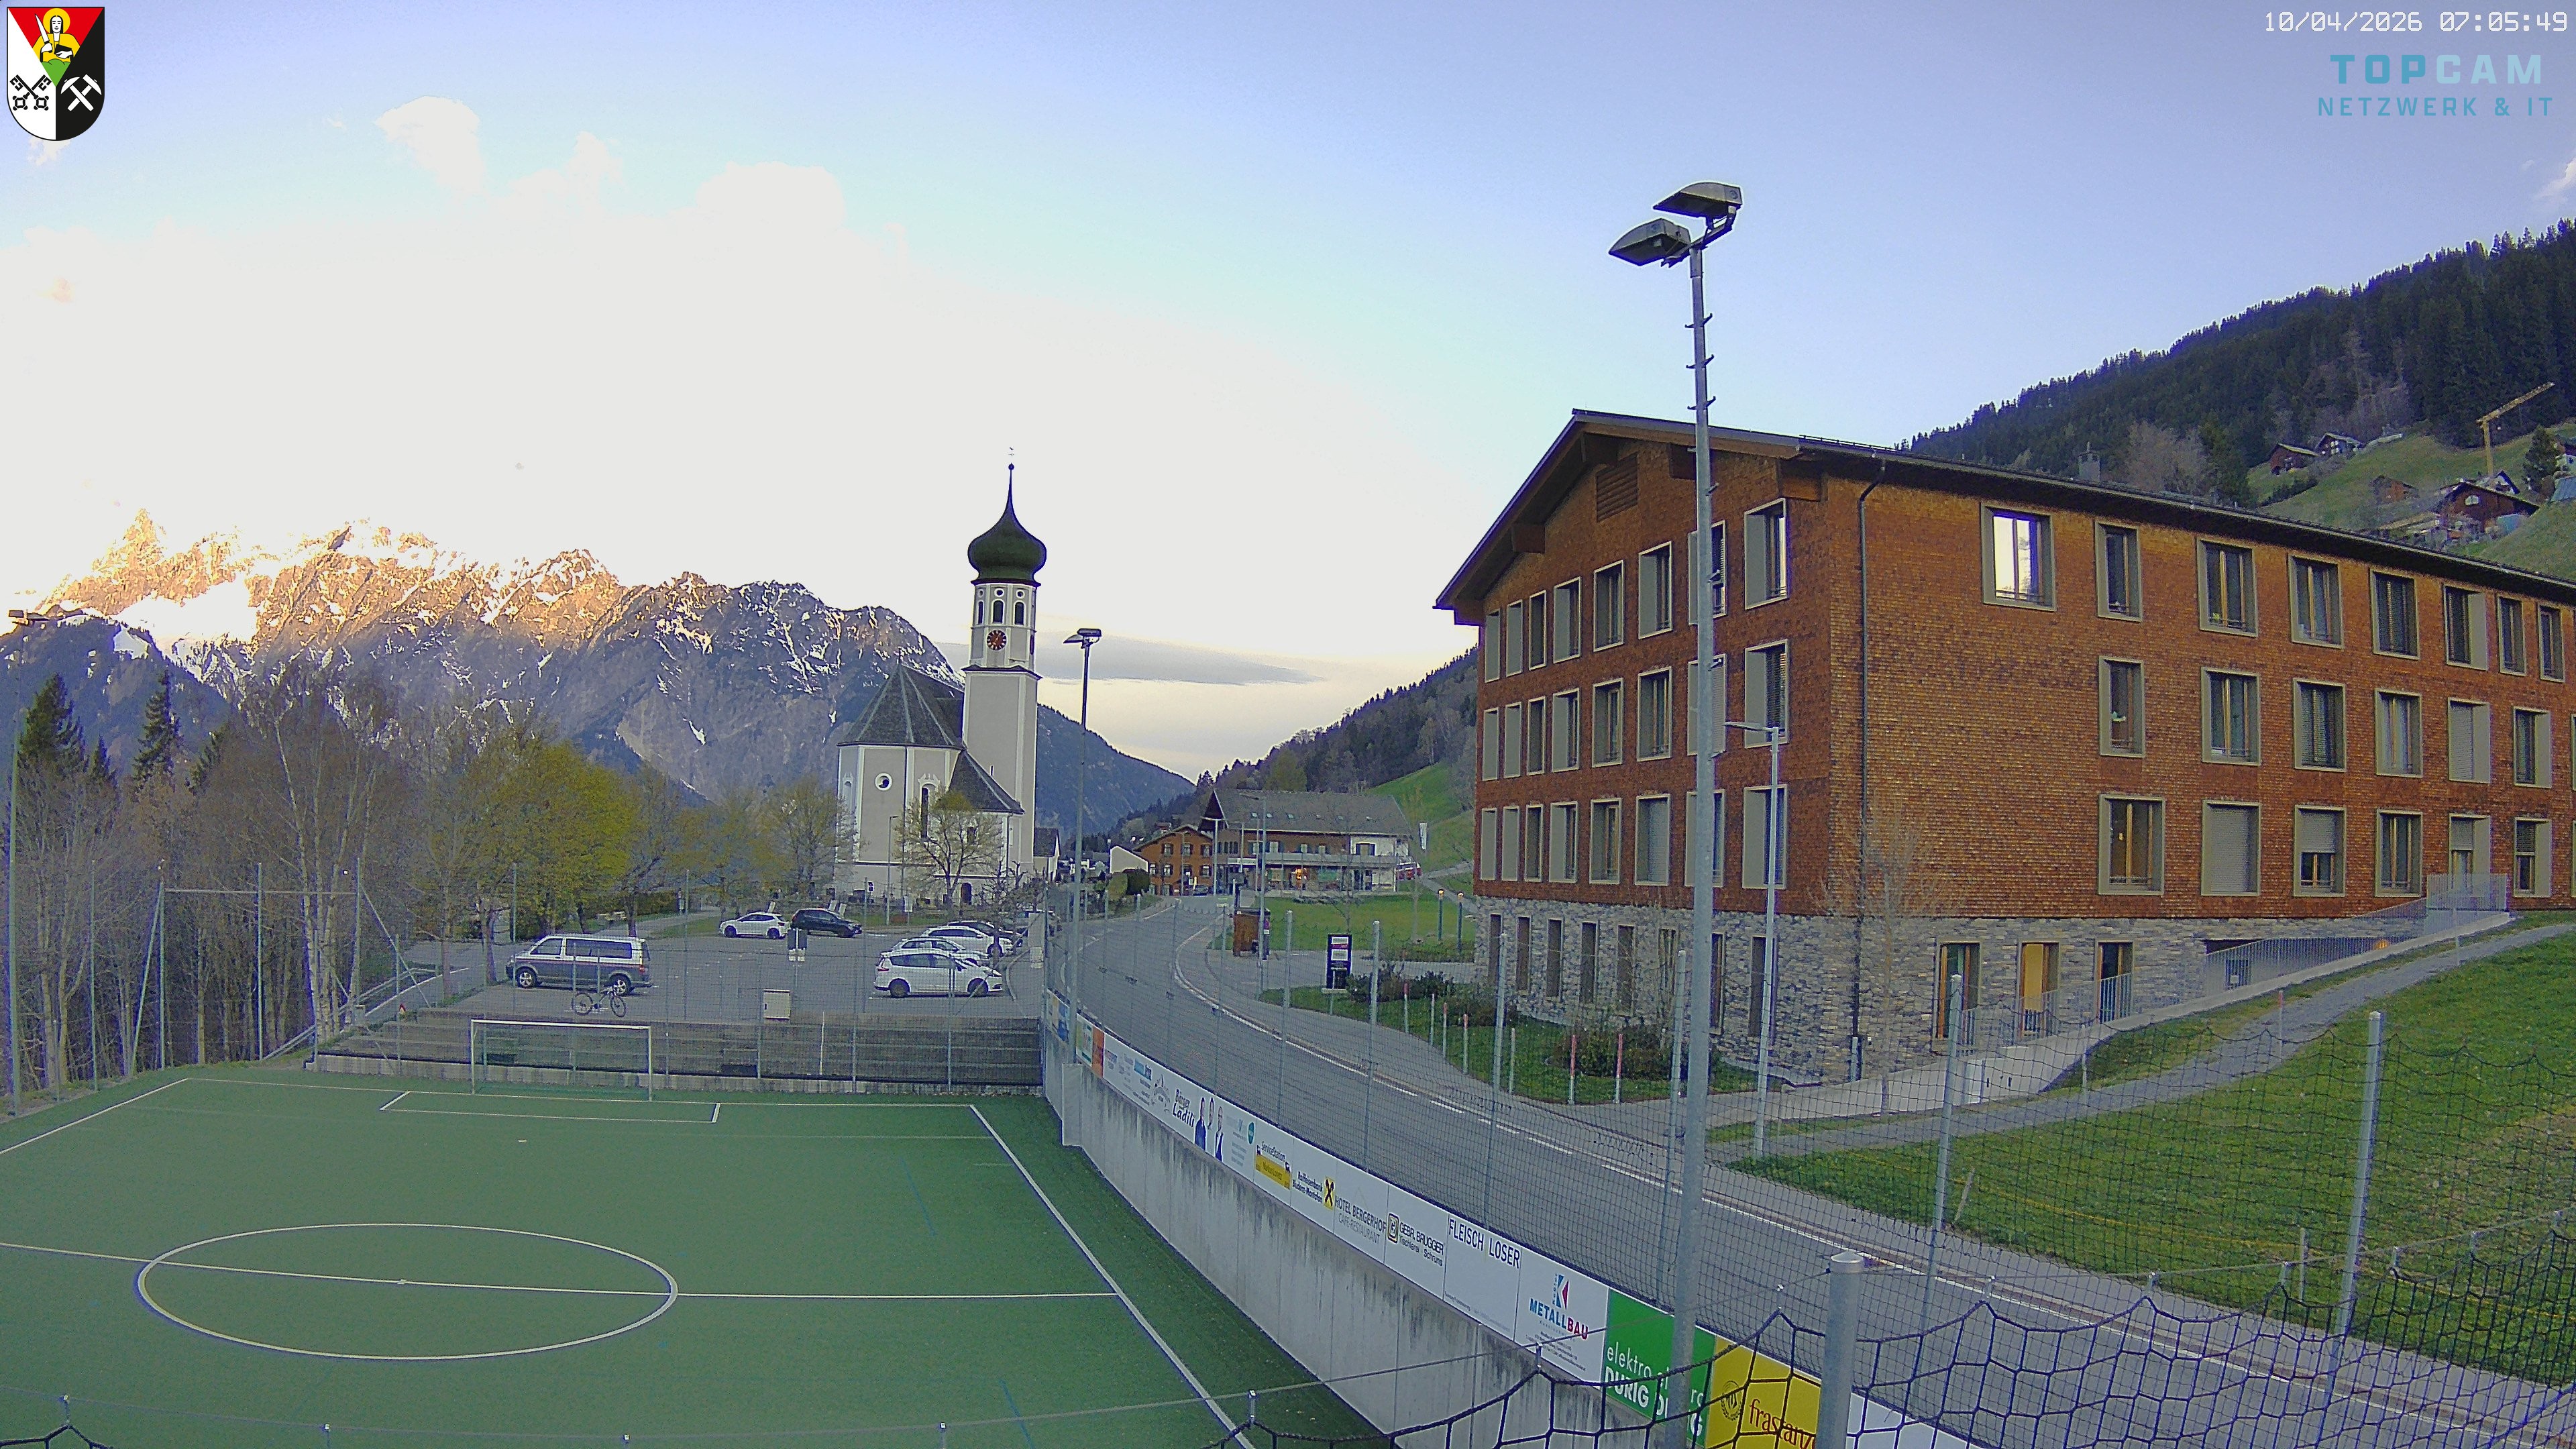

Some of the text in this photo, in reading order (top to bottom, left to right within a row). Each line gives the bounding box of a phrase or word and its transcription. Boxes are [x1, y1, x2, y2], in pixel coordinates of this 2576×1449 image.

[1335, 1195, 1351, 1215] HOTEL
[1352, 1205, 1387, 1233] BERGERHOF
[1400, 1222, 1415, 1240] GEBR.
[1416, 1231, 1444, 1255] BRUGGER
[1449, 1218, 1520, 1269] FLEISCH LOSER
[1529, 1298, 1589, 1340] METALLBAU
[1607, 1341, 1652, 1378] elektro
